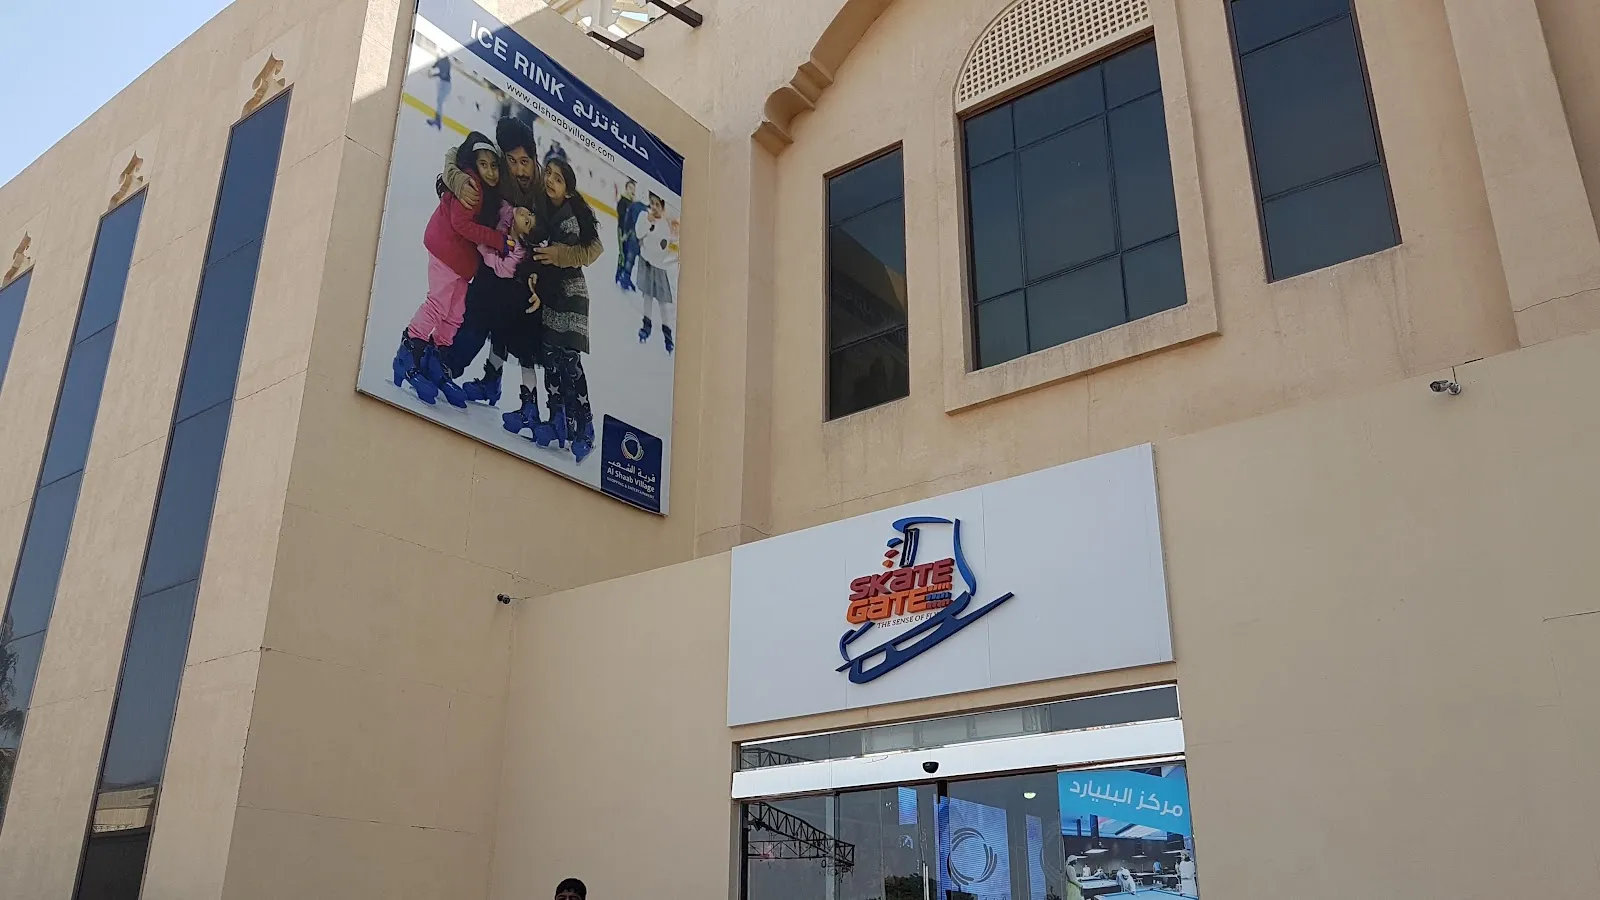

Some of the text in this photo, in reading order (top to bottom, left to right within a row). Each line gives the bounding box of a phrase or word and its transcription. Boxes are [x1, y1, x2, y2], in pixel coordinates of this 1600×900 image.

[470, 20, 565, 103] ICE RINK
[506, 82, 615, 162] www.alshaabvillage.com
[572, 99, 649, 160] حلبة تزلج
[606, 467, 655, 493] Al Shaab Village
[637, 468, 656, 483] قرية
[877, 621, 891, 629] THE
[892, 615, 914, 626] SENSE
[915, 613, 925, 622] OF
[1070, 780, 1183, 817] مركز البليارد
